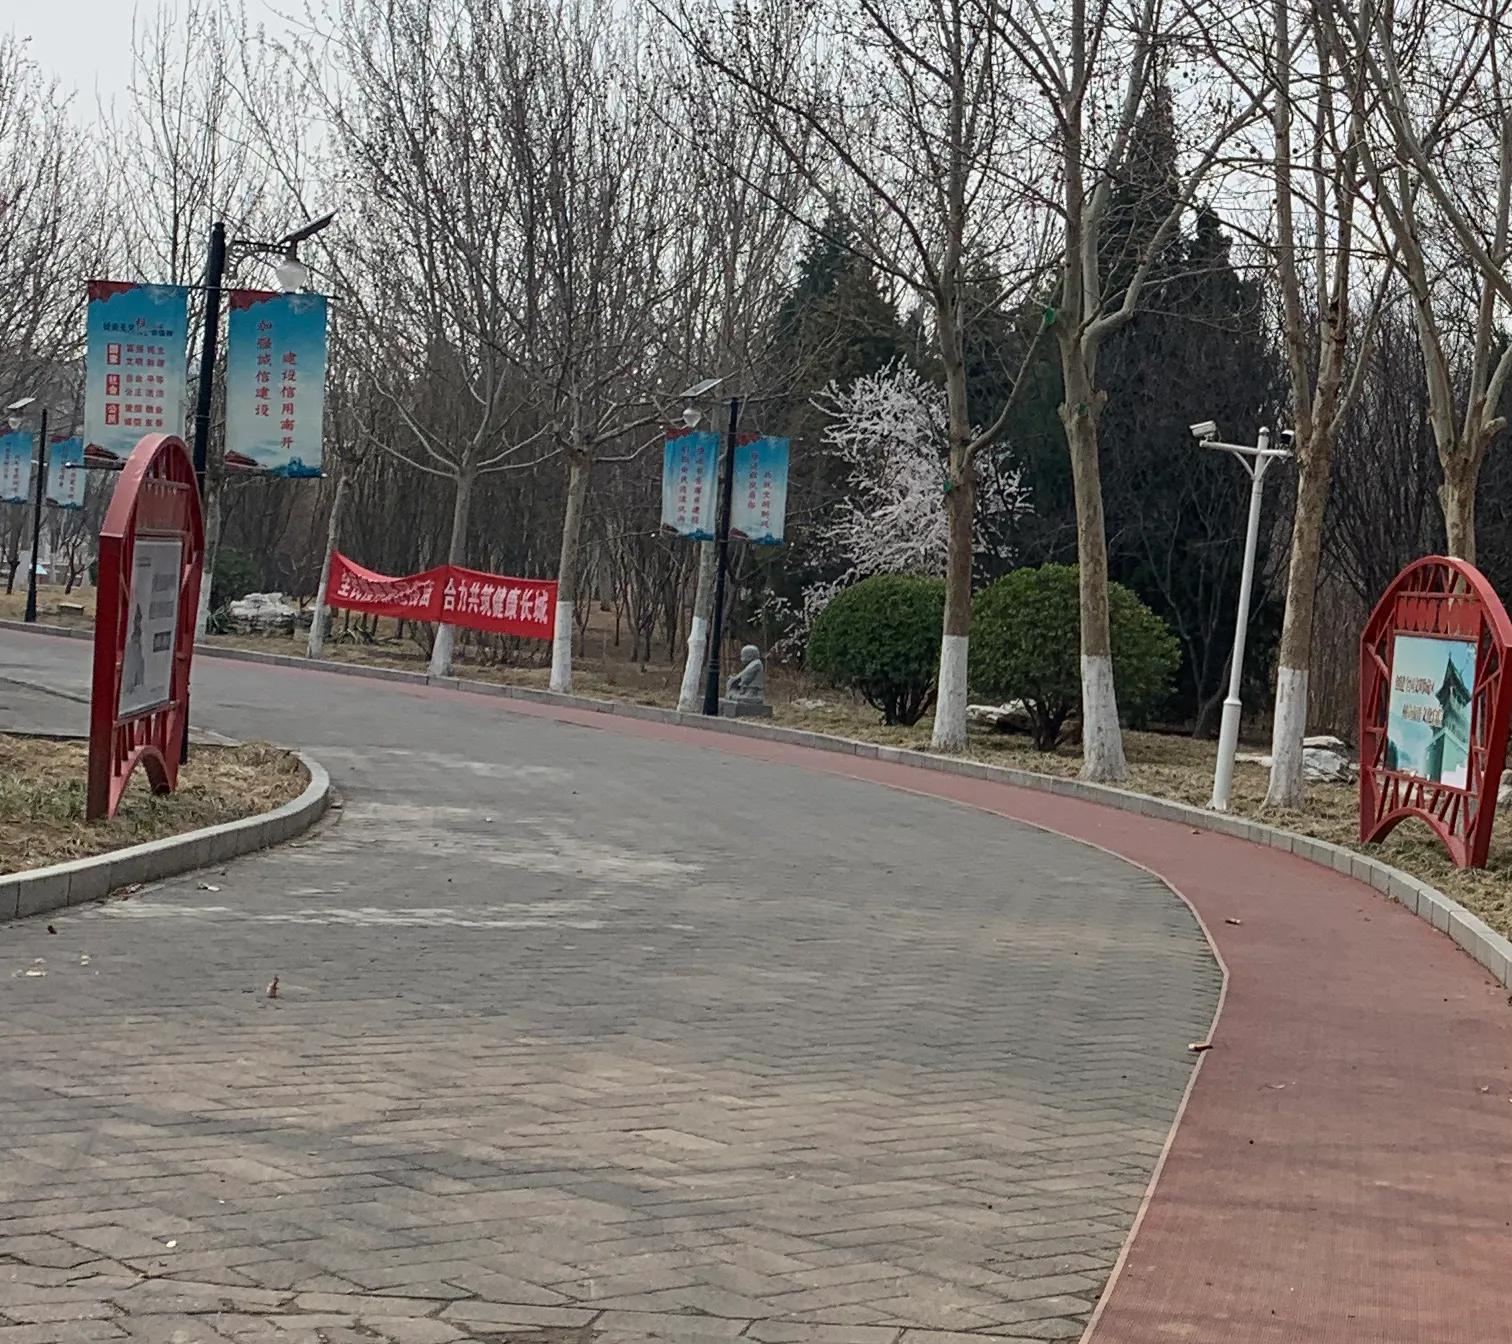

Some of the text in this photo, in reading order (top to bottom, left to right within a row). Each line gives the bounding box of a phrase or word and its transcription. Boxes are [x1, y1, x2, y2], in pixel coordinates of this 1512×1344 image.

[443, 577, 549, 625] 合力共筑健康长城
